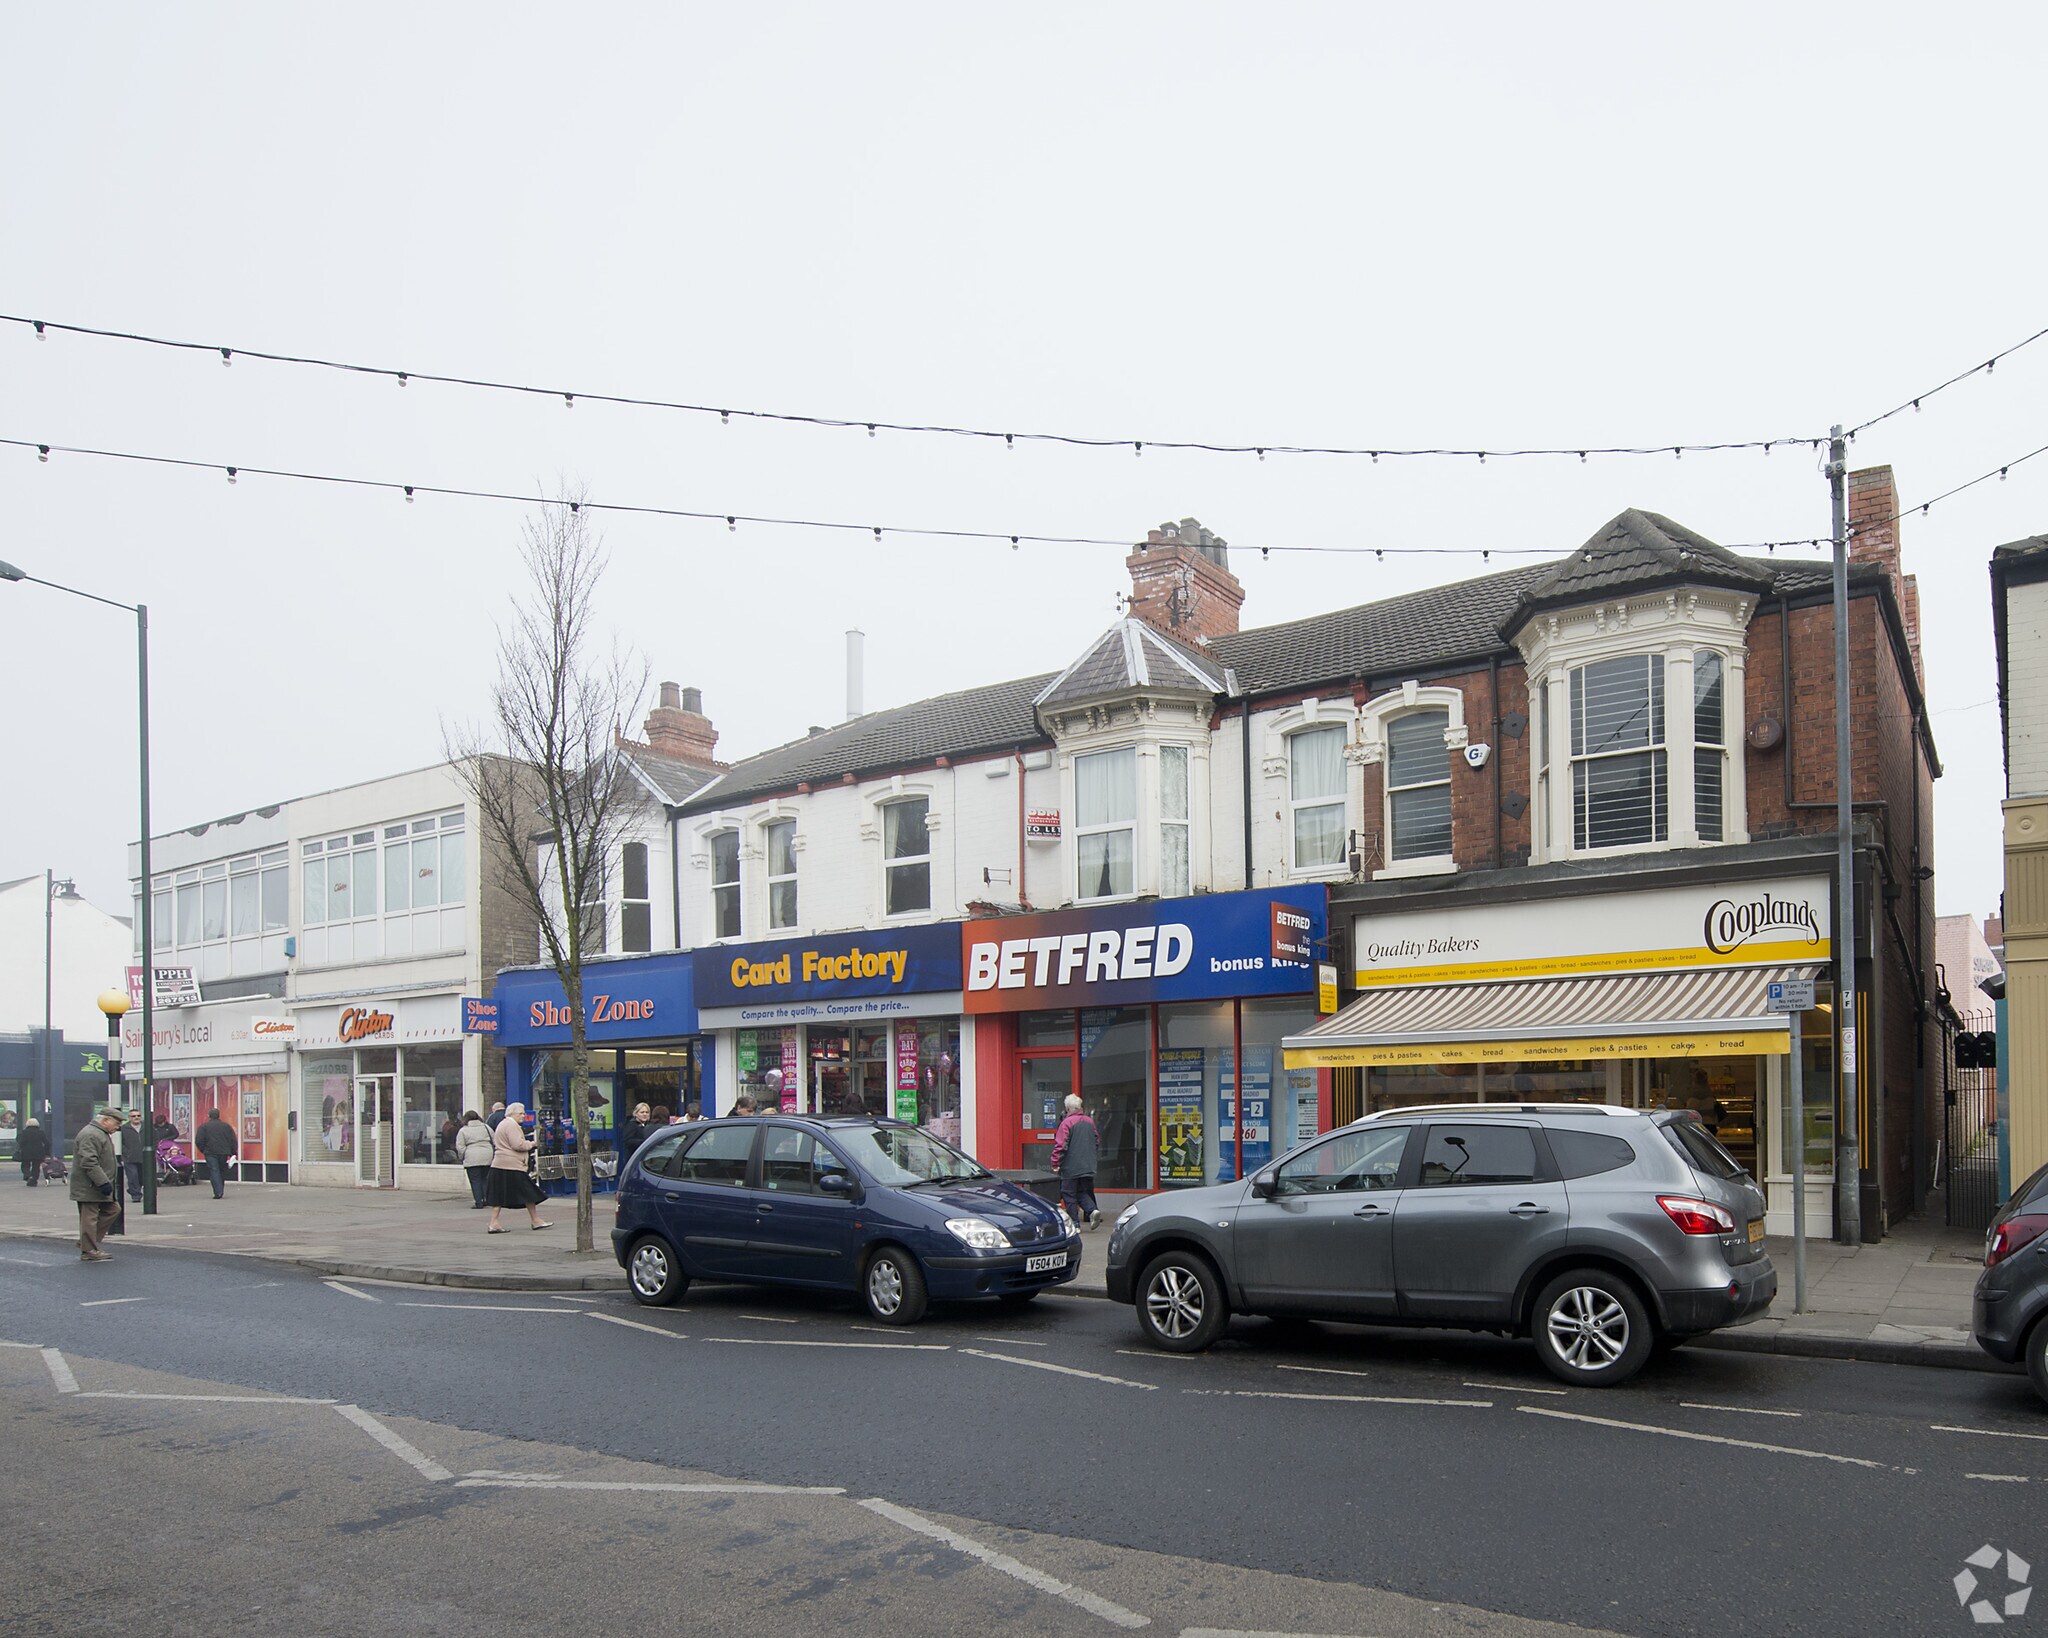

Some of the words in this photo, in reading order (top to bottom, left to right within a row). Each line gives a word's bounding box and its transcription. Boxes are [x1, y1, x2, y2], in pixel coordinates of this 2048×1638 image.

[1276, 911, 1310, 930] BETFRED
[1704, 893, 1820, 954] Cooplands
[1276, 940, 1296, 952] bonus
[1297, 943, 1310, 957] king
[1368, 940, 1424, 962] Quality
[1428, 936, 1480, 954] Bakers
[968, 923, 1193, 992] BETFRED
[1210, 957, 1264, 972] bonus
[158, 970, 187, 979] PPH
[731, 954, 791, 988] Card
[802, 948, 908, 983] Factory
[132, 989, 143, 1000] LE
[1772, 986, 1780, 997] P
[468, 1000, 497, 1015] Shoe
[530, 1001, 585, 1027] Sho
[592, 995, 654, 1022] Zone
[742, 1010, 774, 1020] Compare
[777, 1008, 788, 1016] the
[791, 1006, 824, 1017] quality...
[826, 1004, 863, 1015] Compare
[865, 1002, 878, 1012] the
[880, 1000, 910, 1013] price...
[254, 1021, 295, 1034] Clinton
[339, 1008, 394, 1042] Clinton
[468, 1016, 497, 1031] Zone
[126, 1025, 180, 1050] Saibury's
[184, 1021, 212, 1043] Local
[784, 1049, 795, 1057] DAY
[902, 1041, 914, 1050] DAY
[1524, 1046, 1568, 1055] sandwiches
[1289, 1076, 1311, 1088] YES
[1255, 1104, 1260, 1114] 2
[1232, 1128, 1256, 1139] 60
[1030, 1257, 1050, 1270] V504
